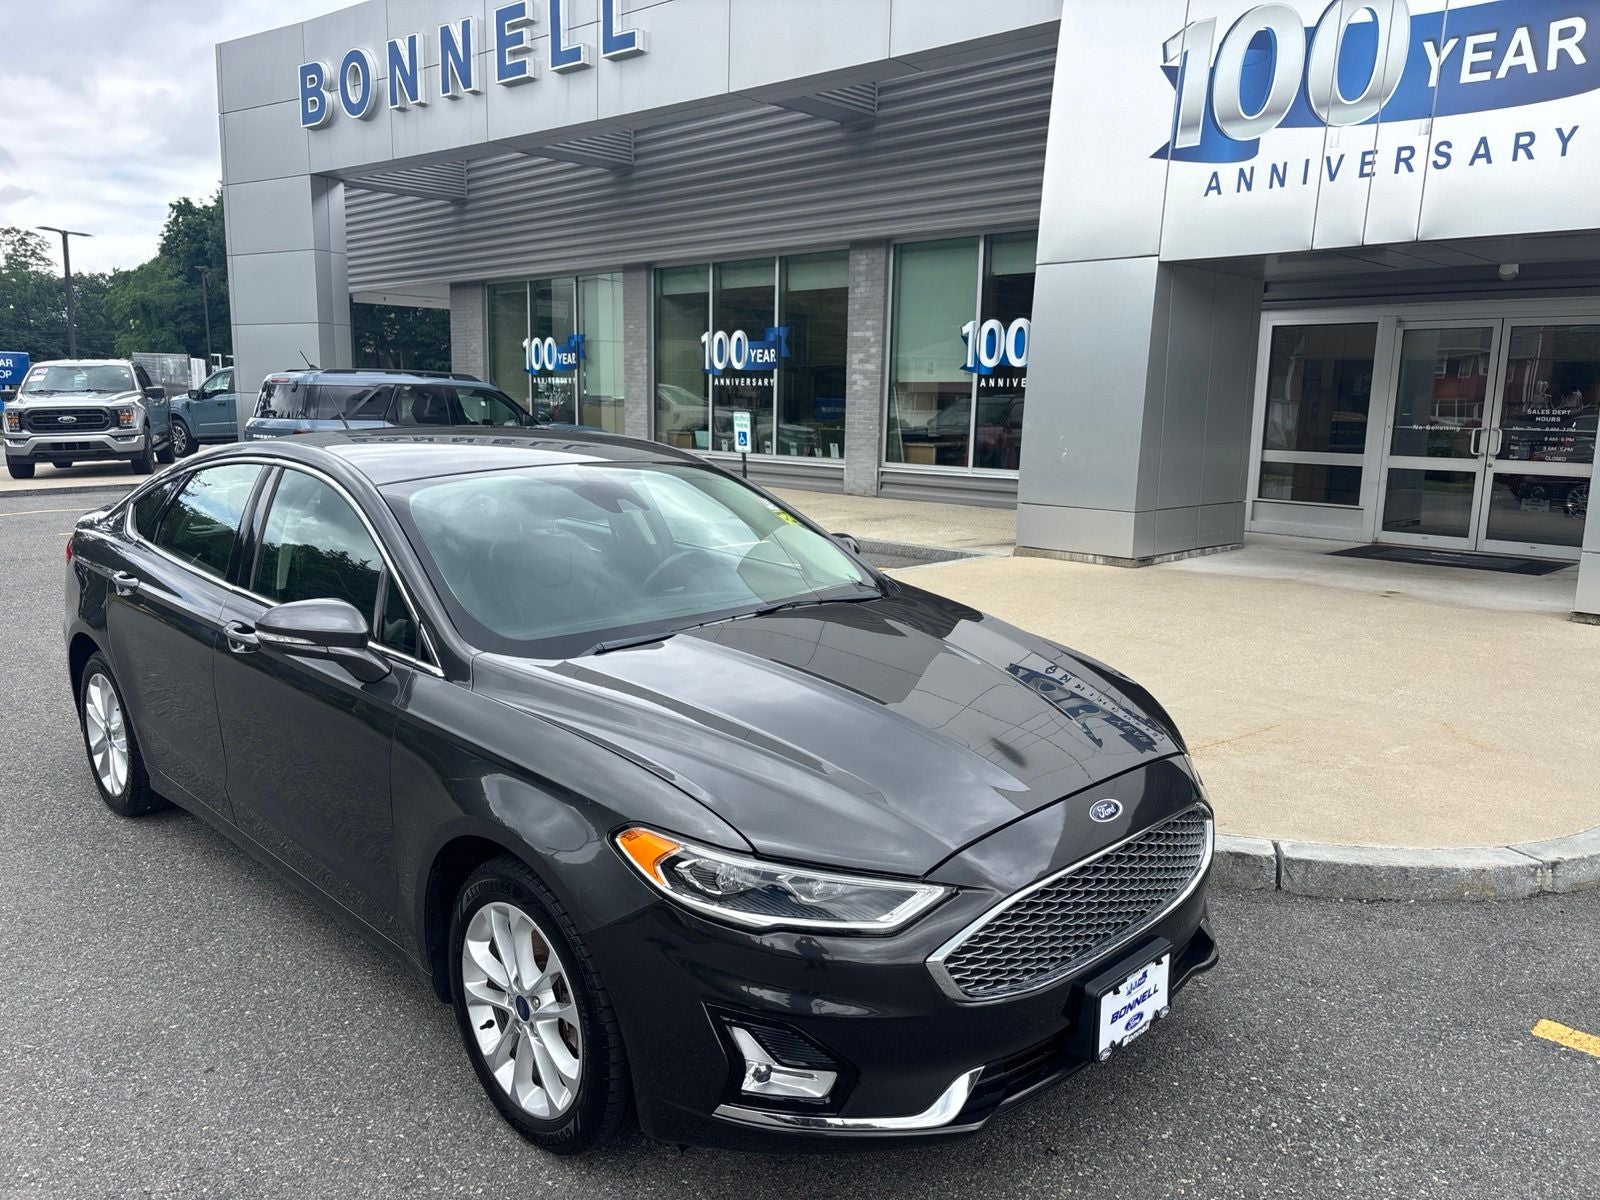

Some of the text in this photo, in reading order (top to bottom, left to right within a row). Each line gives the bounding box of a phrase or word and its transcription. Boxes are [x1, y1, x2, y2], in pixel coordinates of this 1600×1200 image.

[298, 0, 641, 128] BONNELL
[1162, 0, 1588, 149] 100 YEAR
[1203, 125, 1579, 197] ANNIVERSARY
[523, 337, 576, 370] 100 YEAR
[701, 330, 776, 370] 100 YEAR
[961, 318, 1030, 368] 100
[714, 378, 775, 387] ANNIVERSARY
[1097, 803, 1117, 818] Ford
[1110, 983, 1158, 1025] BONNELL
